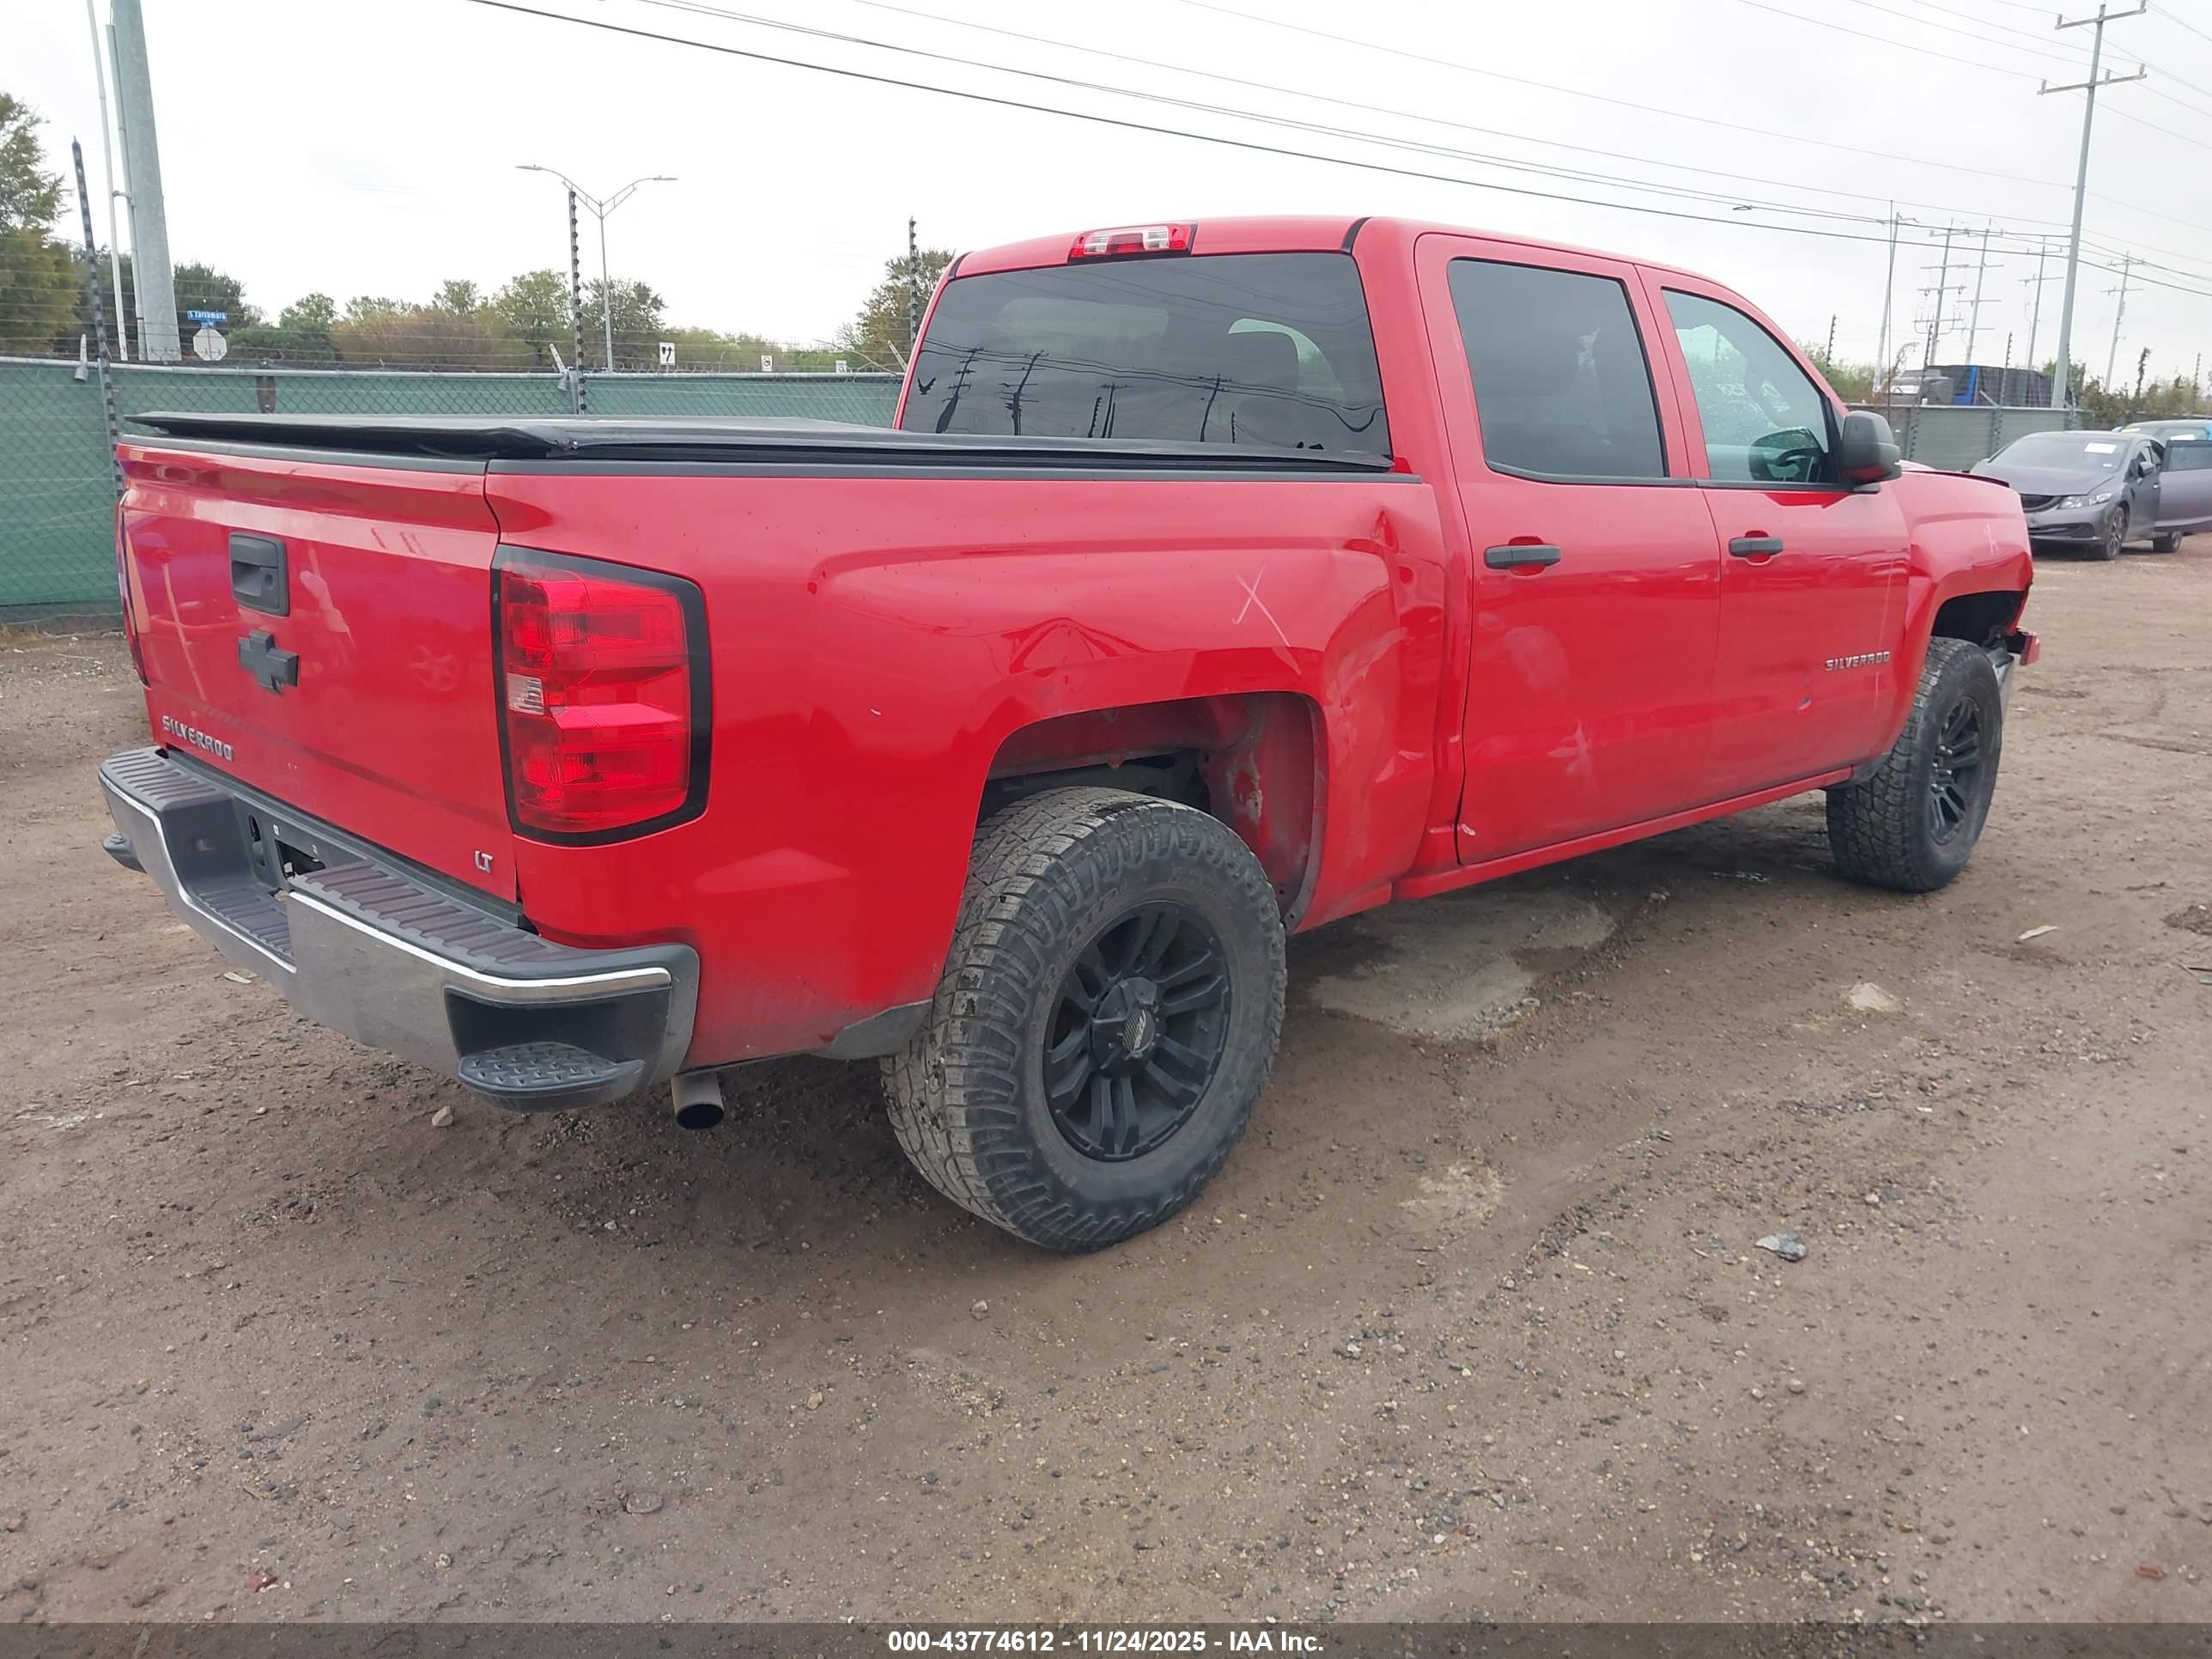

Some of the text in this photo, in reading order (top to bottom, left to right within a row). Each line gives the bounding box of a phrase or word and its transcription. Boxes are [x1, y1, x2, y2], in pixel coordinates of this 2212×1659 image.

[1826, 651, 1890, 671] SILVERADO
[161, 714, 234, 763] SILVERADO
[474, 850, 494, 873] LT
